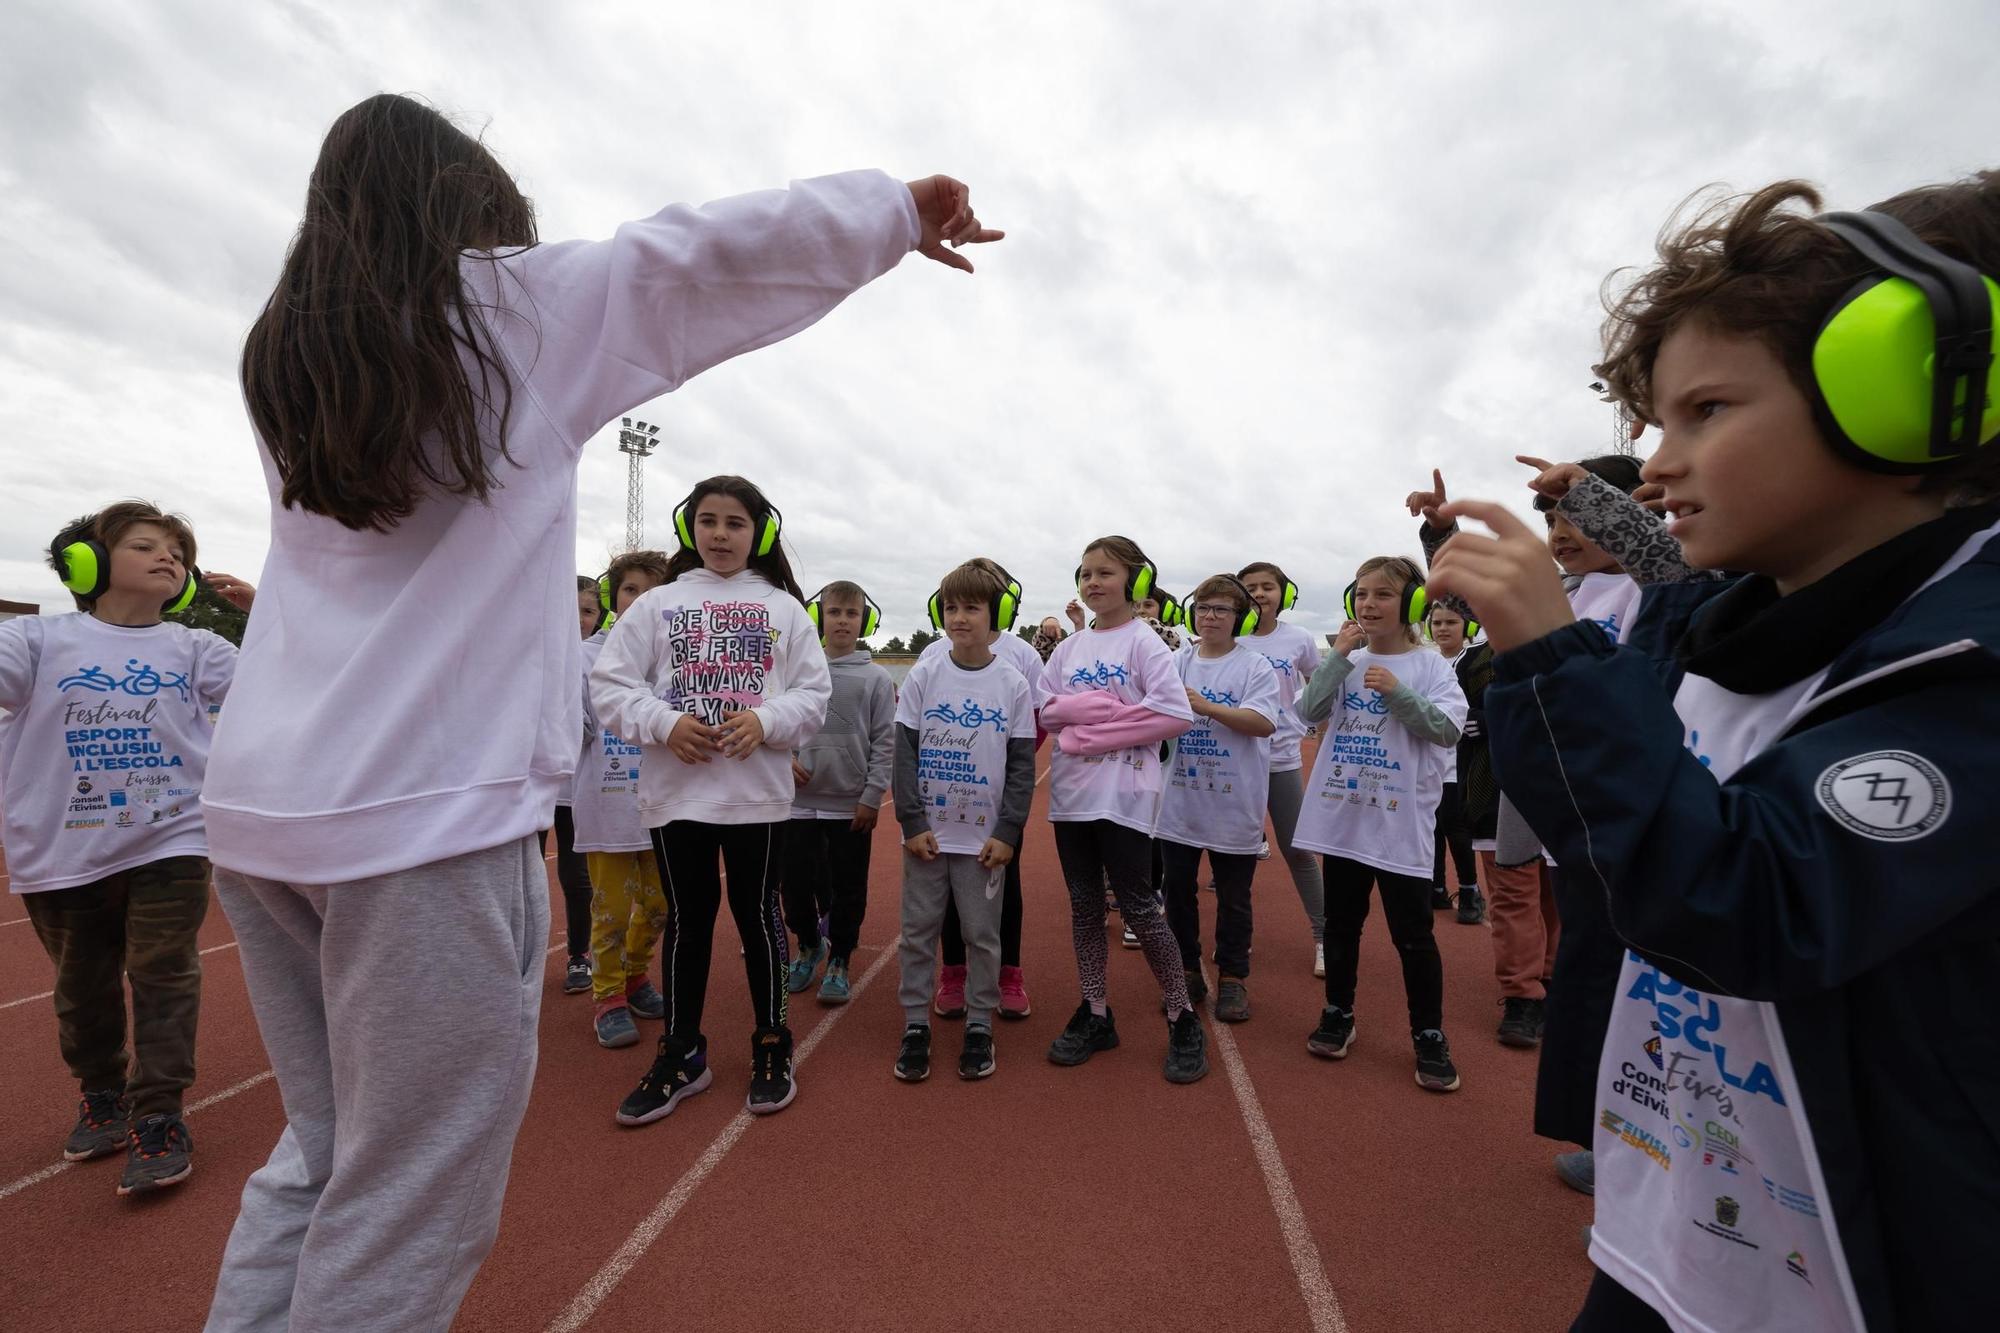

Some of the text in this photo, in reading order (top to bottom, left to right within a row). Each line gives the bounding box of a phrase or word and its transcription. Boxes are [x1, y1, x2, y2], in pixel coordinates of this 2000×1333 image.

[669, 609, 702, 638] BE
[671, 635, 772, 669] BE FREE
[671, 666, 764, 699] ALWAYS
[64, 698, 158, 725] Festival
[65, 727, 152, 743] ESPORT
[921, 728, 979, 750] Festival
[1335, 734, 1381, 747] ESPORT
[67, 741, 162, 758] INCLUSIU
[604, 747, 614, 755] A
[920, 748, 971, 761] ESPORT
[1333, 744, 1388, 758] INCLUSIU
[74, 755, 183, 772] A L'ESCOLA
[918, 759, 976, 773] INCLUSIU
[1331, 754, 1401, 771] A L'ESCOLA
[125, 771, 171, 787] Eivissa
[928, 770, 989, 785] L'ESCOLA
[1627, 972, 1657, 1006] A
